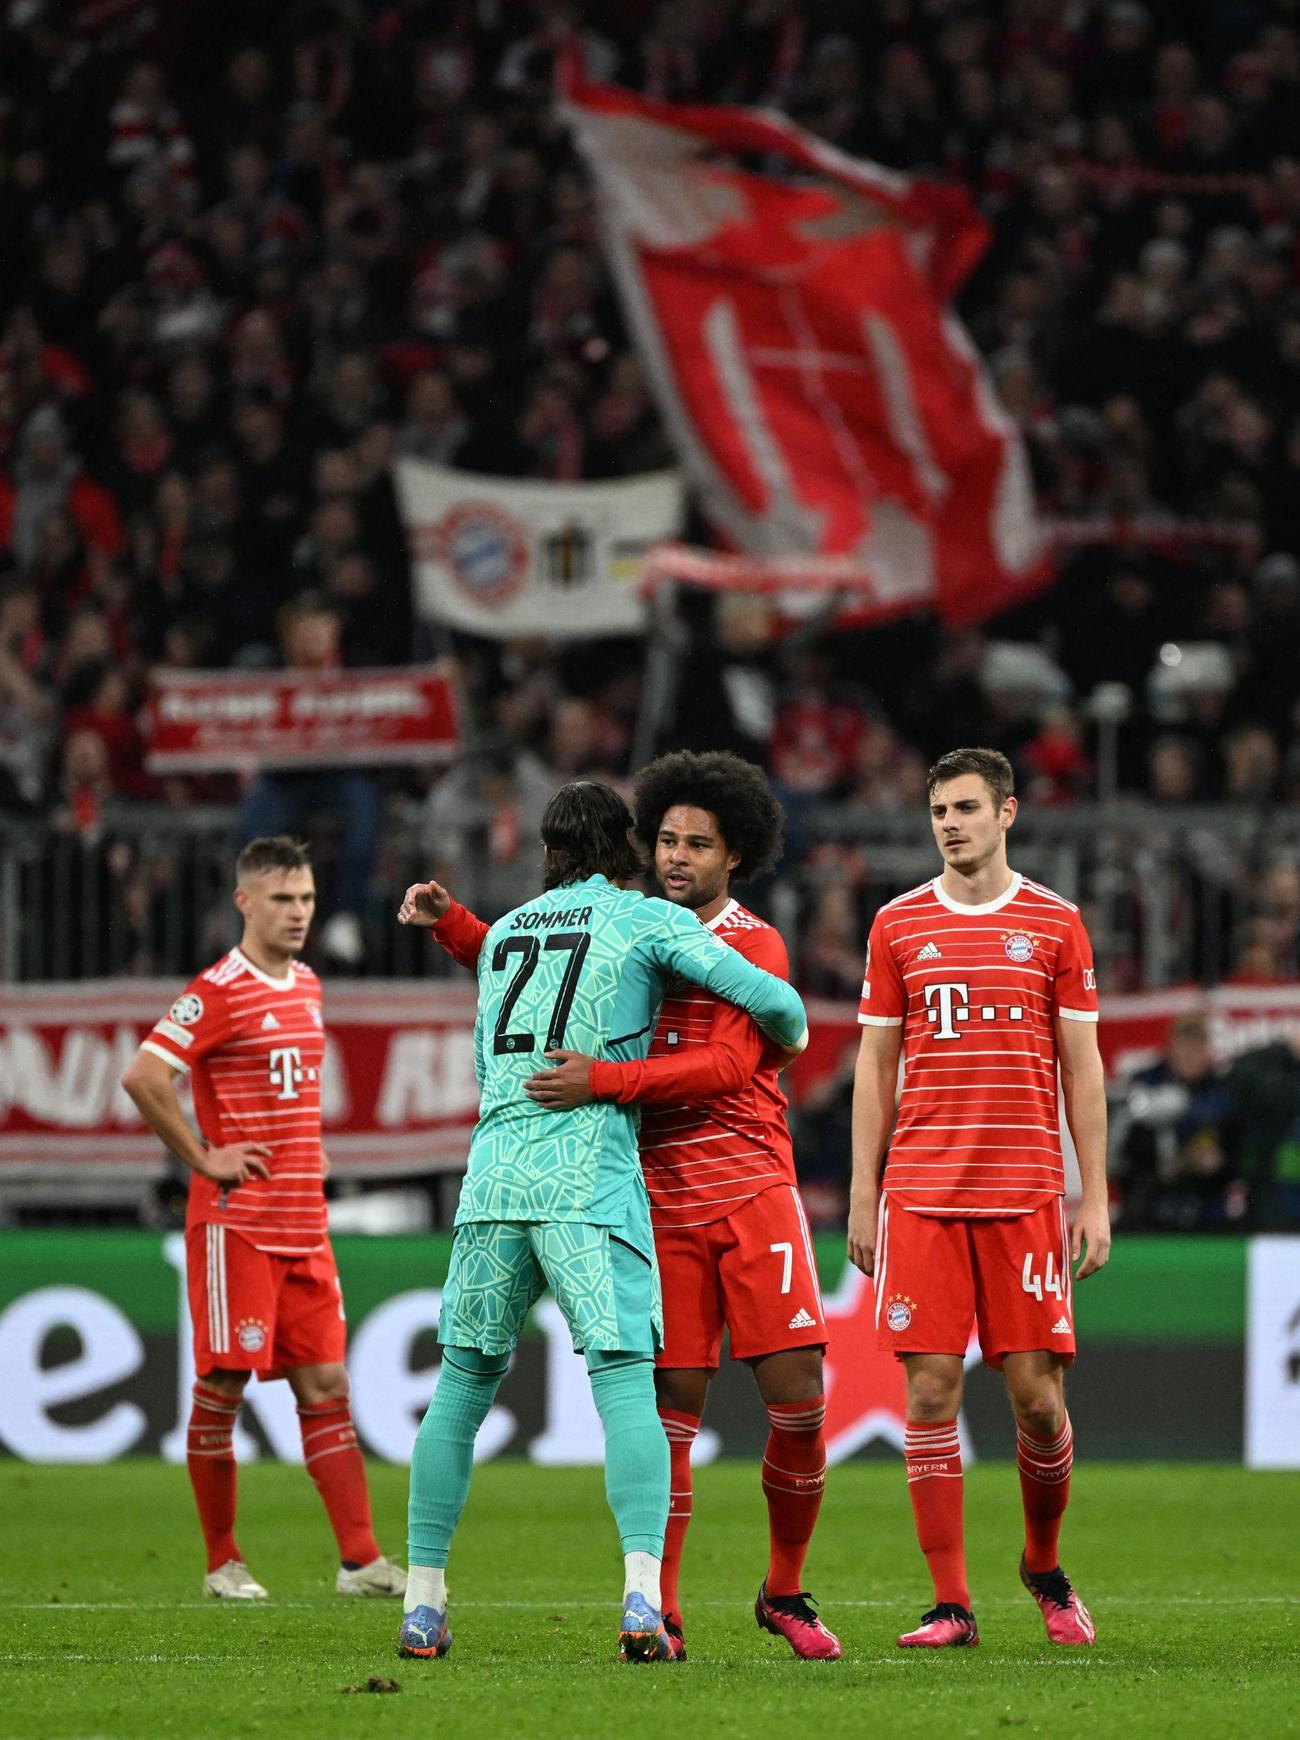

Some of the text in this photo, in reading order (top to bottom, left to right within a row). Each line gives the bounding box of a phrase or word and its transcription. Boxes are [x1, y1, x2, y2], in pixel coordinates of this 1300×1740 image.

[510, 906, 593, 930] SOMMER
[917, 951, 942, 960] adidas
[491, 931, 592, 1056] 27
[770, 1242, 793, 1294] 7
[1022, 1251, 1063, 1301] 44
